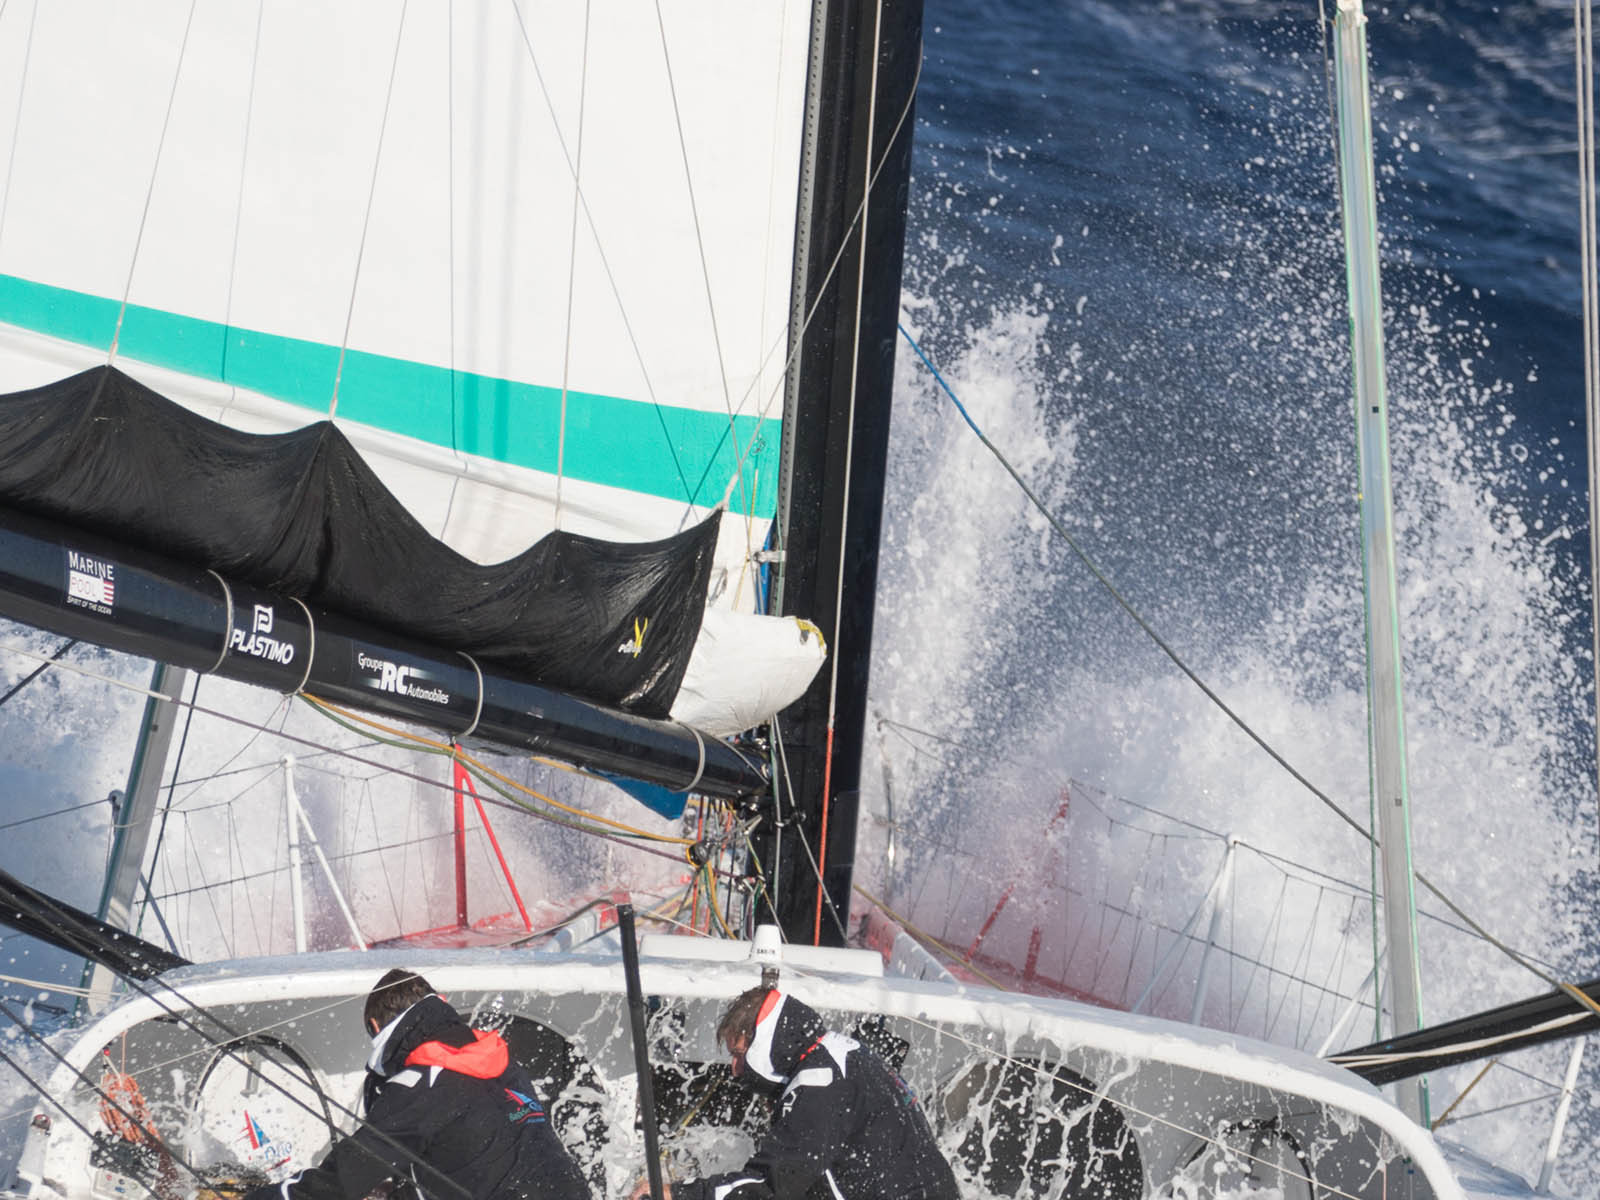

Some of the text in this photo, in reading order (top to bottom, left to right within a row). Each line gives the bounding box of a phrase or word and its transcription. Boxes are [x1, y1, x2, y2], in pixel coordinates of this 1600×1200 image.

[69, 551, 115, 580] MARINE
[230, 628, 294, 665] PLASTIMO
[358, 653, 449, 704] Groupe RC Automobiles
